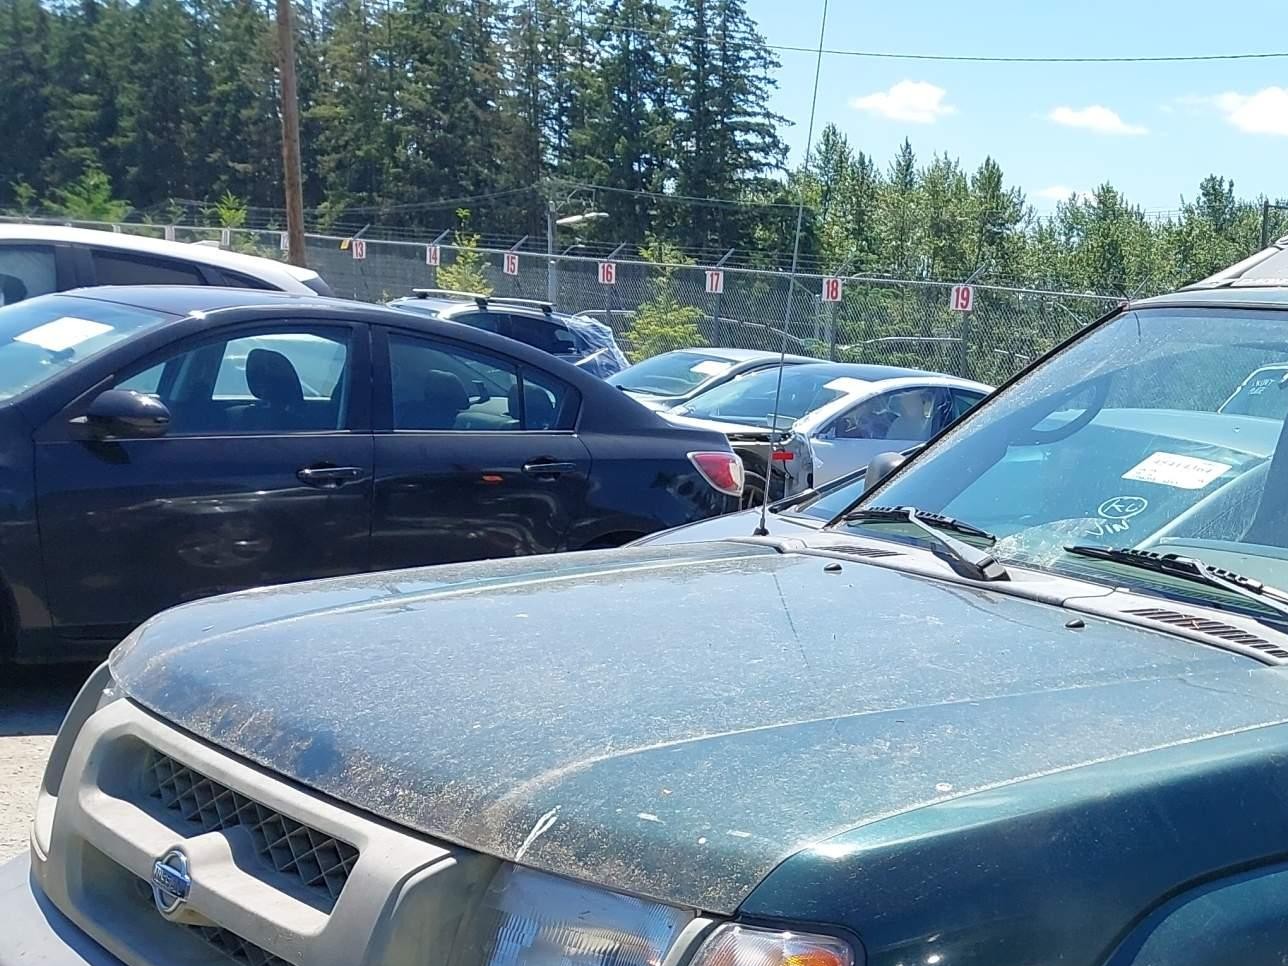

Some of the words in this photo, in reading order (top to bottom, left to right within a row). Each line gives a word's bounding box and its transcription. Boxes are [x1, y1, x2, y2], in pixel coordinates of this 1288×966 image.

[354, 241, 364, 258] 13
[428, 247, 438, 264] 14
[506, 255, 516, 274] 15
[601, 264, 613, 283] 16
[709, 272, 720, 291] 17
[826, 279, 838, 300] 18
[955, 287, 970, 309] 19
